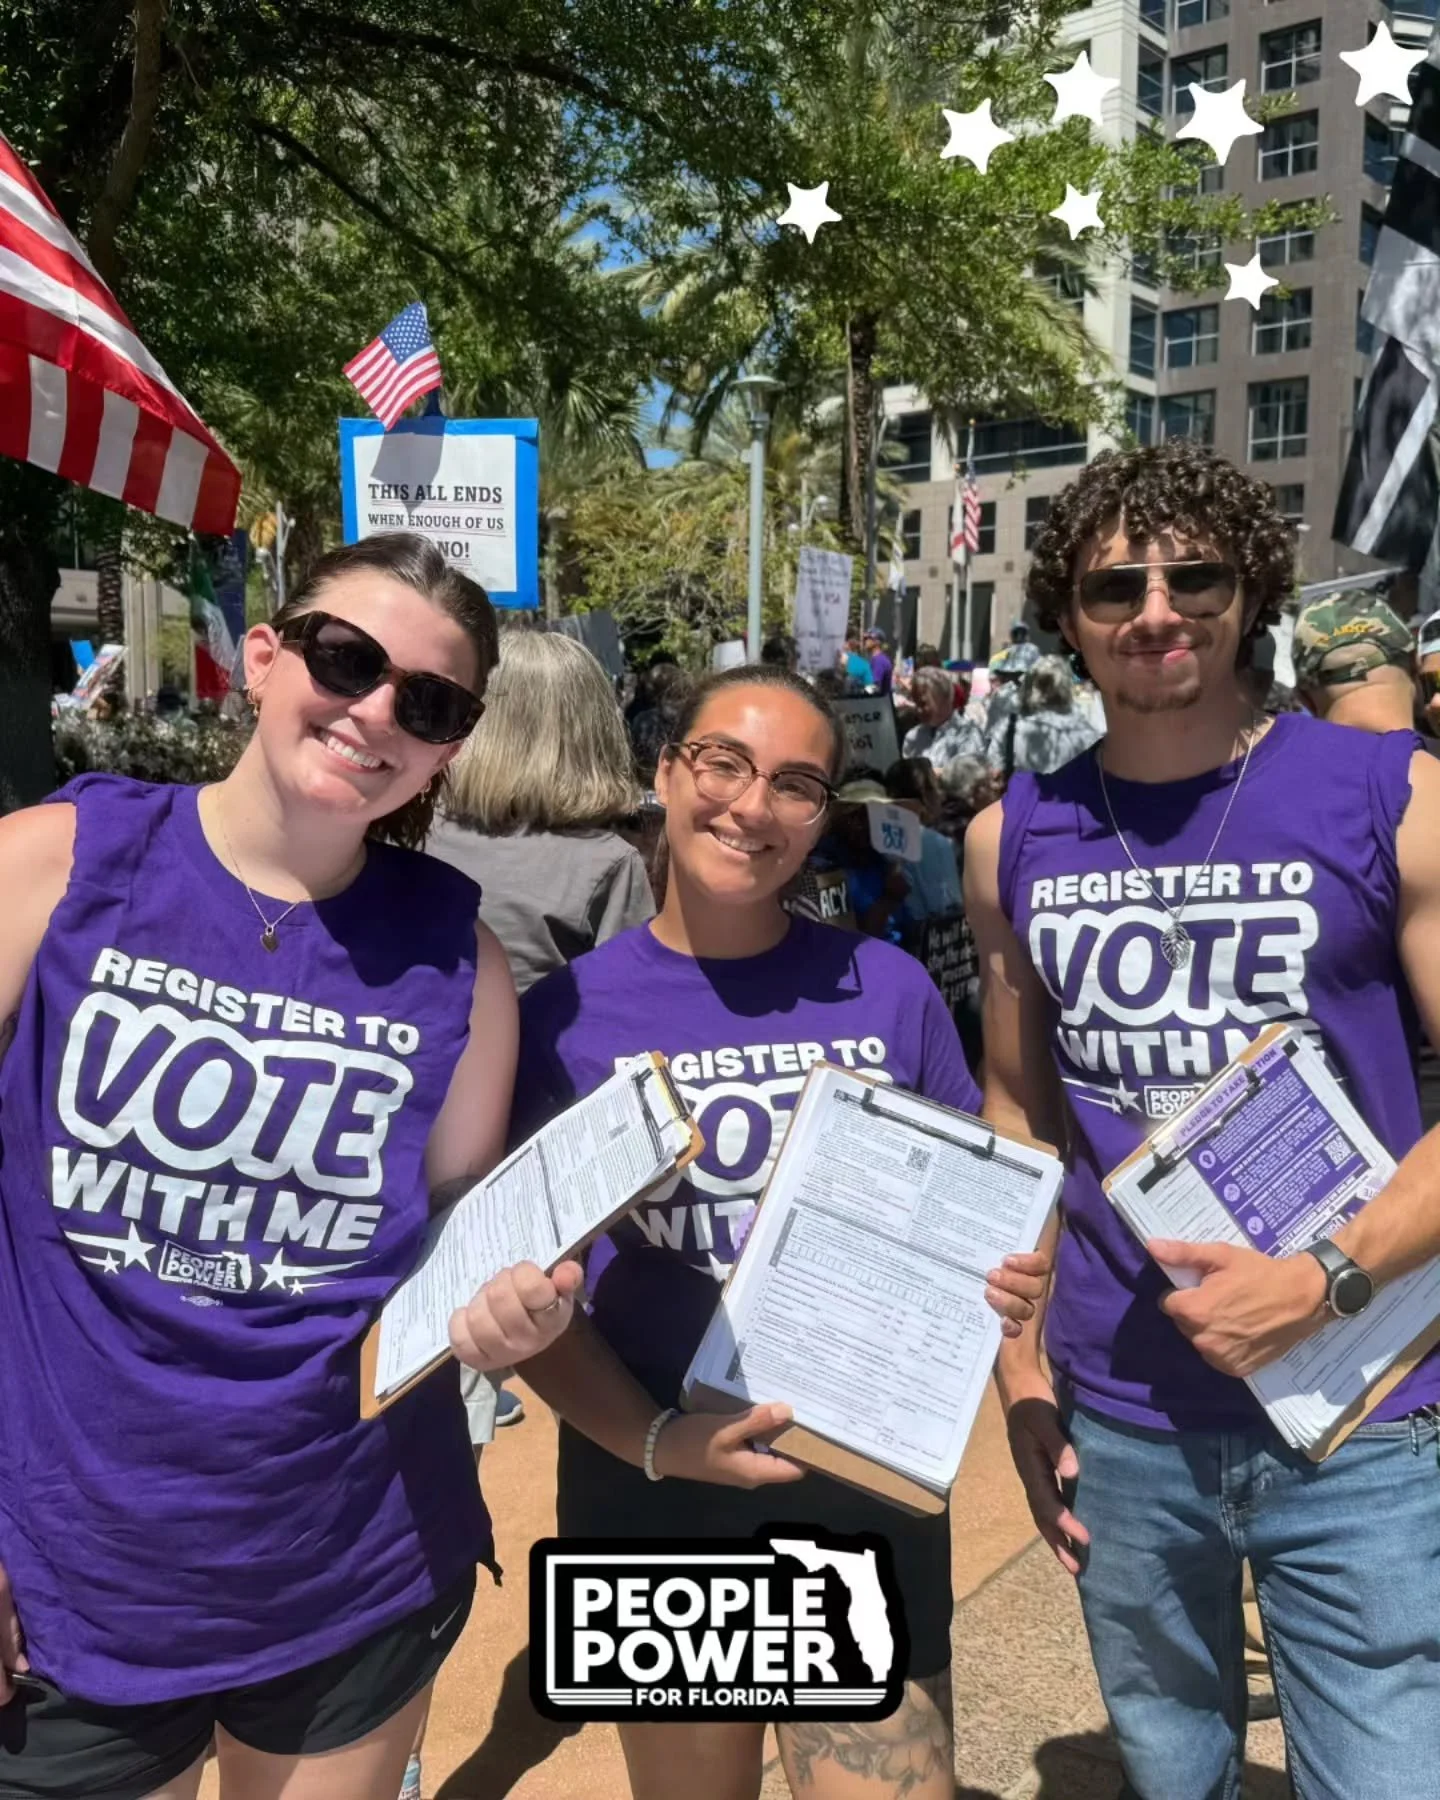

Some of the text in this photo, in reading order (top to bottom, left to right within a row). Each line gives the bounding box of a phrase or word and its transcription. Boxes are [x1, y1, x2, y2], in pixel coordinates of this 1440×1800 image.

[368, 484, 503, 503] THIS ALL ENDS
[368, 513, 504, 529] WHEN ENOUGH OF US
[438, 541, 470, 558] NO!
[1031, 862, 1313, 909] REGISTER TO
[1029, 900, 1319, 1026] VOTE
[91, 947, 419, 1055] REGISTER TO
[614, 1037, 886, 1082] GISTER TO
[1057, 1026, 1211, 1077] WITH
[1253, 1048, 1278, 1074] CTION
[60, 994, 412, 1196] VOTE
[1150, 1090, 1197, 1102] PEOP
[51, 1146, 384, 1250] WITH ME
[628, 1200, 758, 1251] WIT
[166, 1260, 237, 1289] POWER
[169, 1247, 237, 1273] PEOPLE
